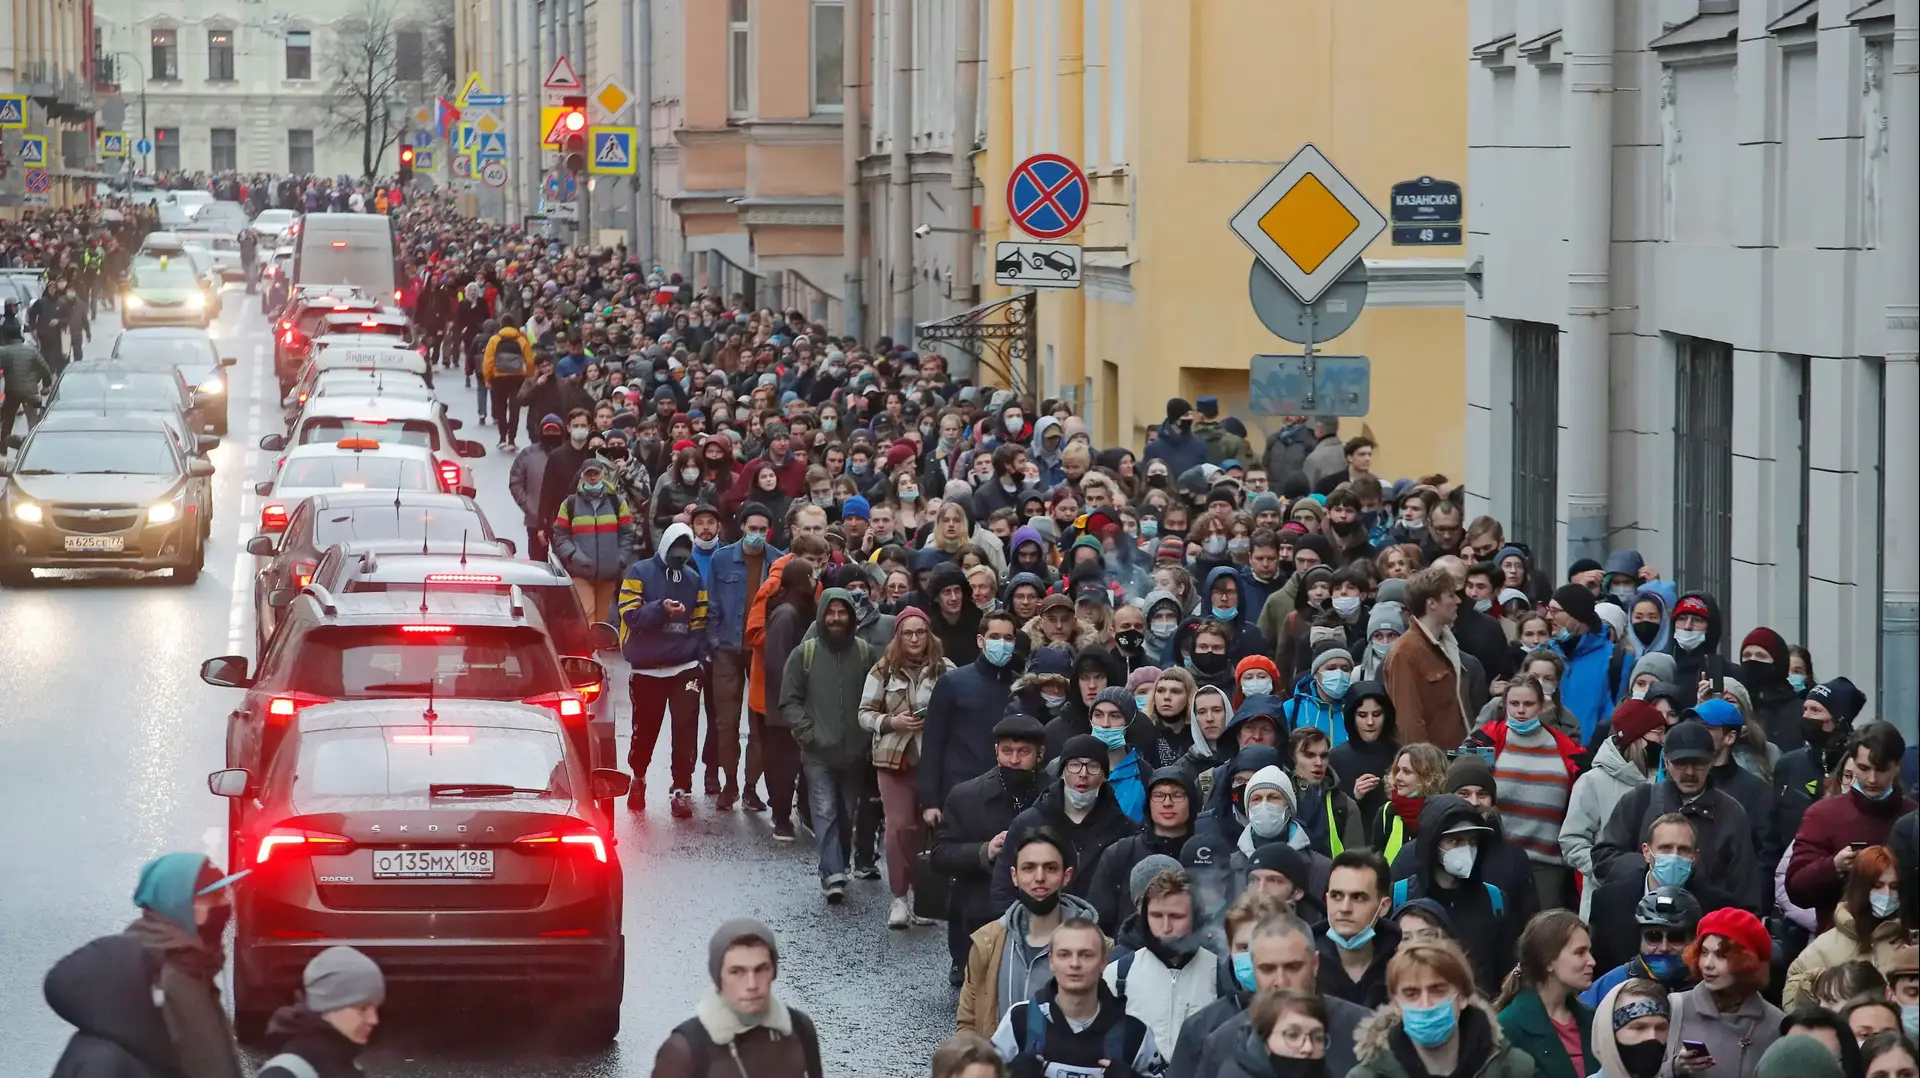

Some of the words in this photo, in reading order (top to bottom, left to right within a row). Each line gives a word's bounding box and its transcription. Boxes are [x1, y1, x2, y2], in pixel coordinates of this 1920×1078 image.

[488, 169, 503, 181] 40
[1396, 194, 1458, 206] КАЗАНСКАЯ
[1419, 229, 1434, 242] 49
[460, 852, 488, 866] 198
